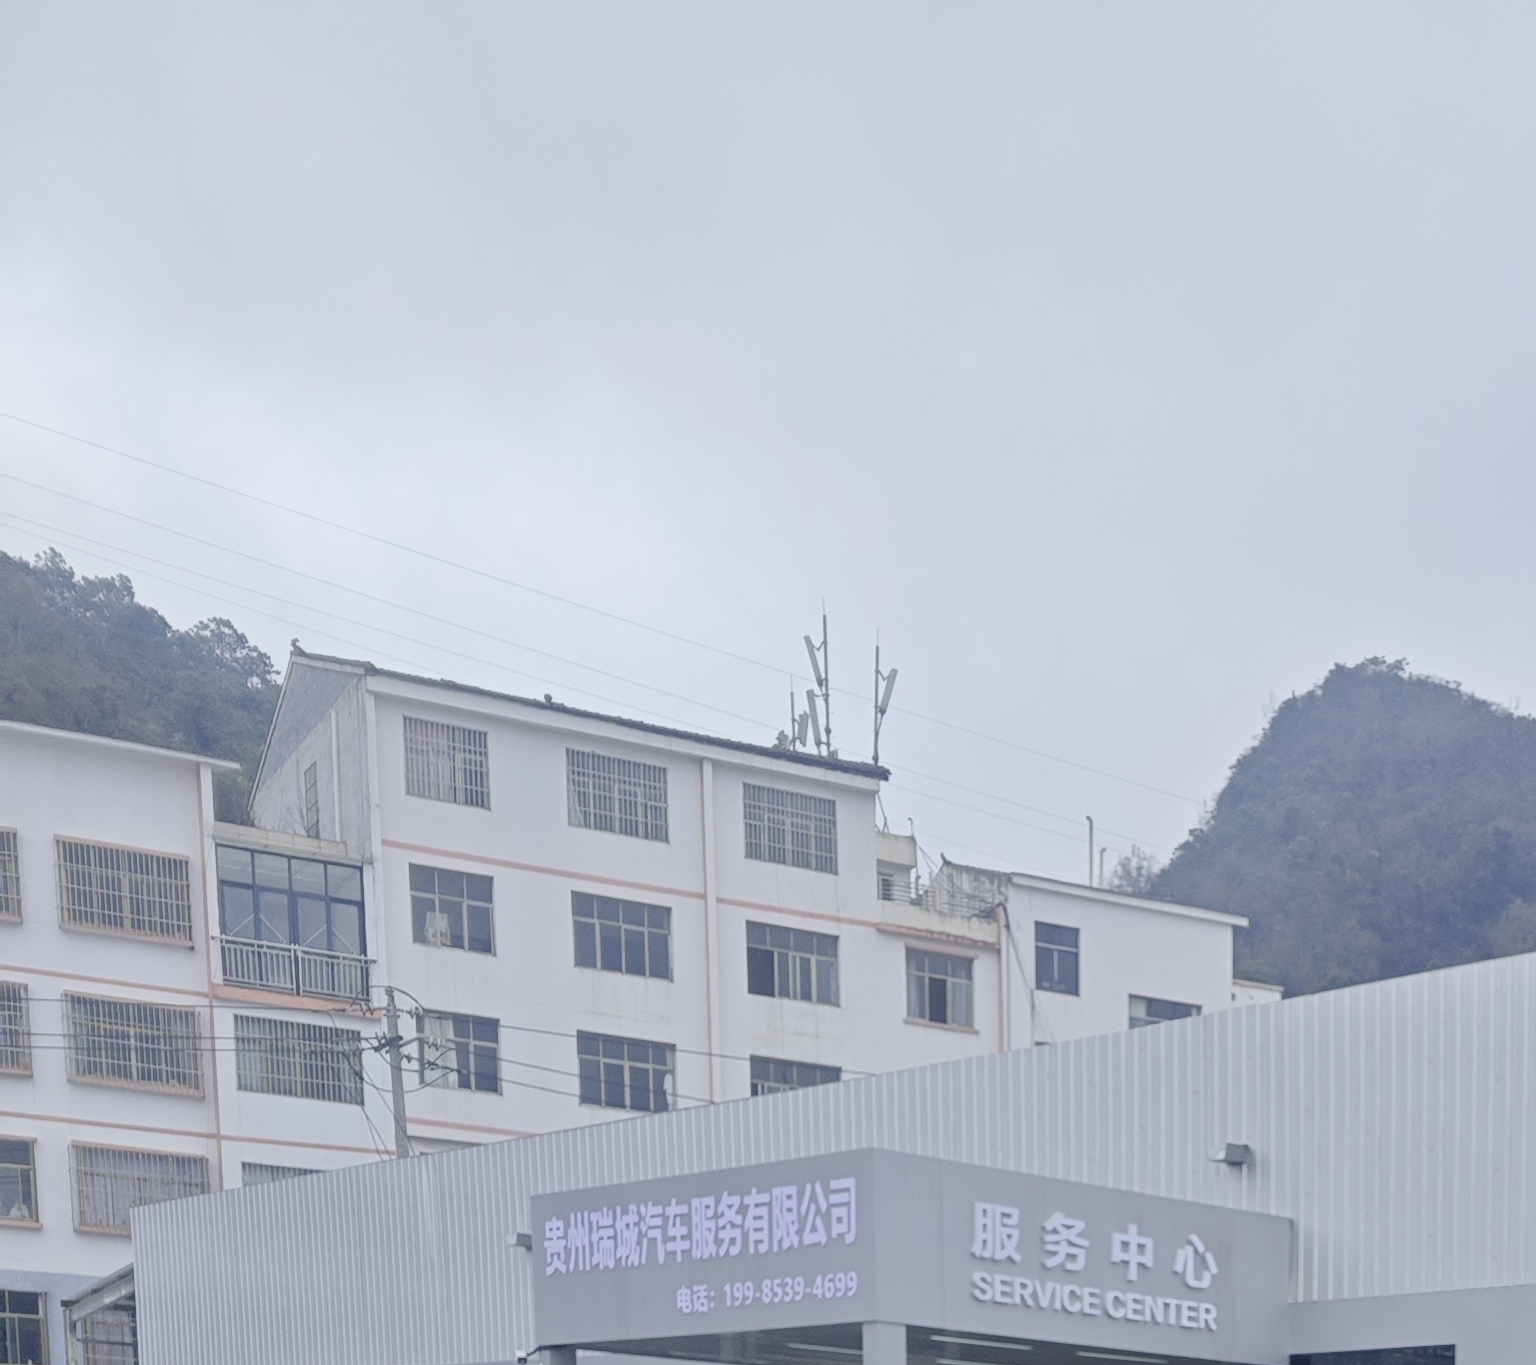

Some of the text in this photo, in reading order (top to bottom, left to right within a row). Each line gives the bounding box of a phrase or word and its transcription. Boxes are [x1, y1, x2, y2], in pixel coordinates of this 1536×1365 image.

[544, 1177, 857, 1276] 贵州瑞城汽车服务有限公司
[971, 1201, 1219, 1289] 服务中心
[972, 1272, 1218, 1331] SERVICE CENTER
